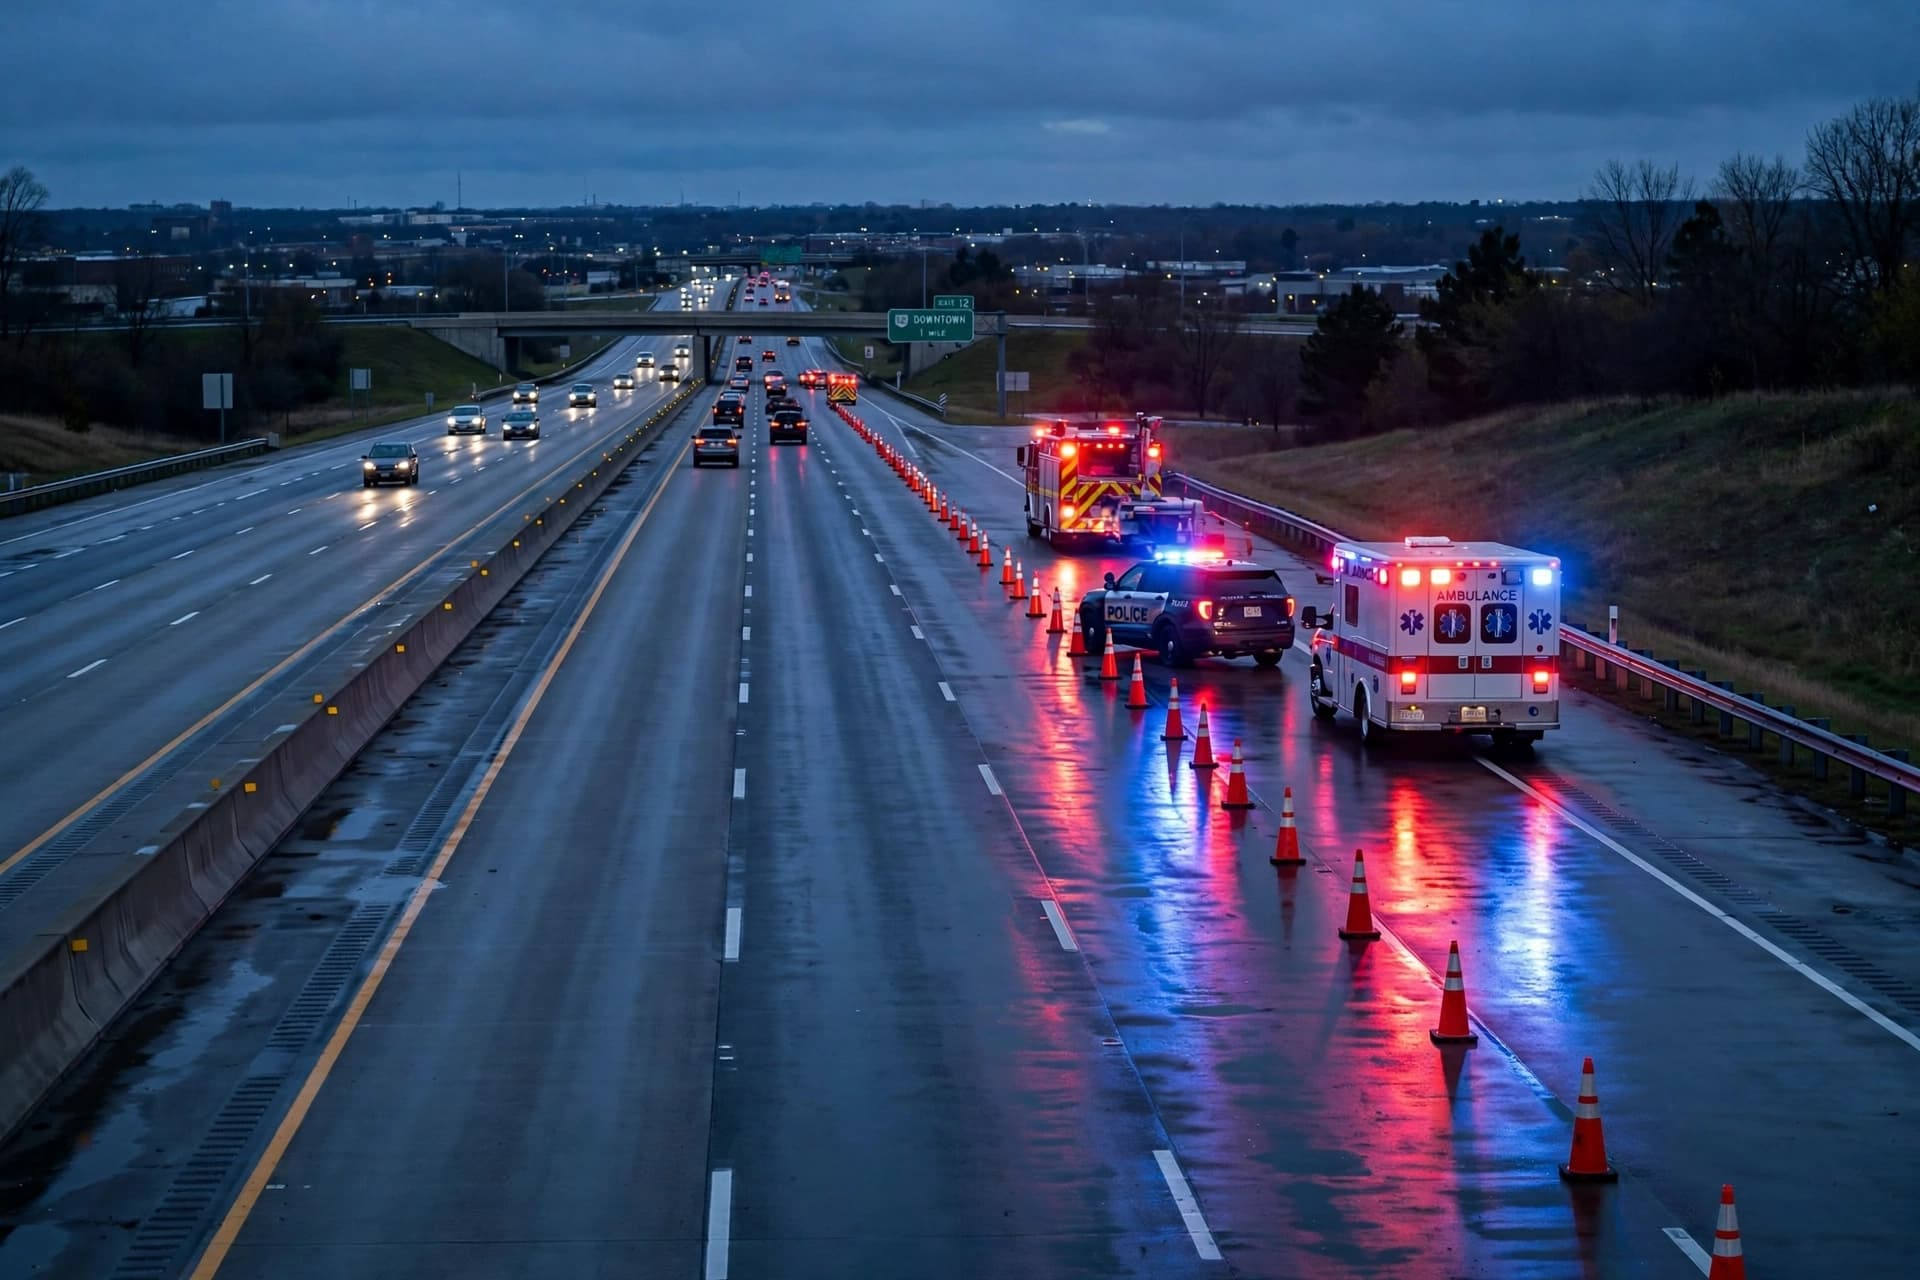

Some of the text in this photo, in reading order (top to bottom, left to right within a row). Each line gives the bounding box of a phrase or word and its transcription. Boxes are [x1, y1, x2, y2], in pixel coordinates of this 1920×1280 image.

[959, 298, 969, 308] 12
[913, 314, 966, 324] DOWNTOWN
[928, 329, 947, 337] MILE
[1437, 590, 1517, 601] AMBULANCE
[1107, 605, 1149, 622] POLICE
